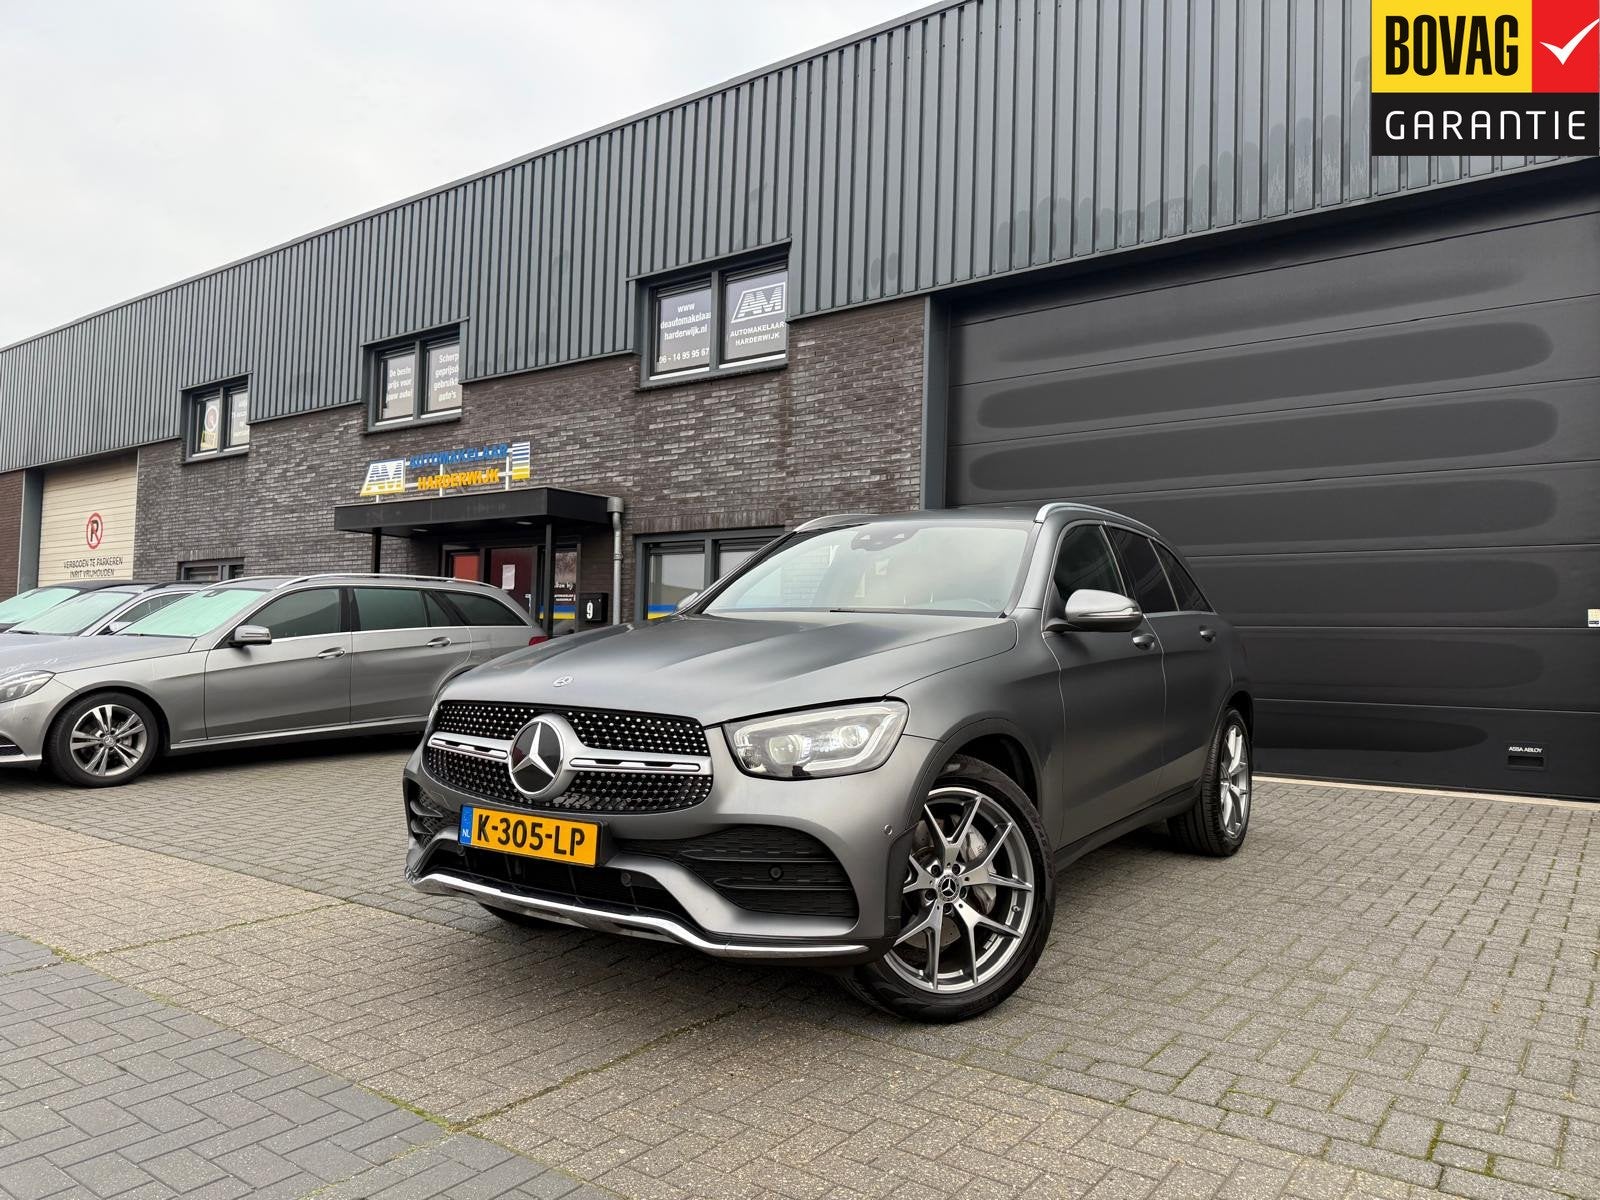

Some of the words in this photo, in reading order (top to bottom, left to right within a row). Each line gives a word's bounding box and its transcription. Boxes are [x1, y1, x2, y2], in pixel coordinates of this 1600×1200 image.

[677, 303, 695, 312] www
[660, 312, 711, 329] deautomakelaa
[729, 320, 785, 337] AUTOMAKELAAR
[664, 324, 708, 340] harderwijk.nl
[735, 332, 780, 346] HARDERWIJK
[691, 349, 700, 358] 95
[410, 443, 509, 468] AUTOMAKELAAR
[418, 468, 499, 490] HARDERWIJK
[586, 602, 594, 619] 9
[462, 829, 470, 838] NL
[477, 813, 585, 856] K-305-LP
